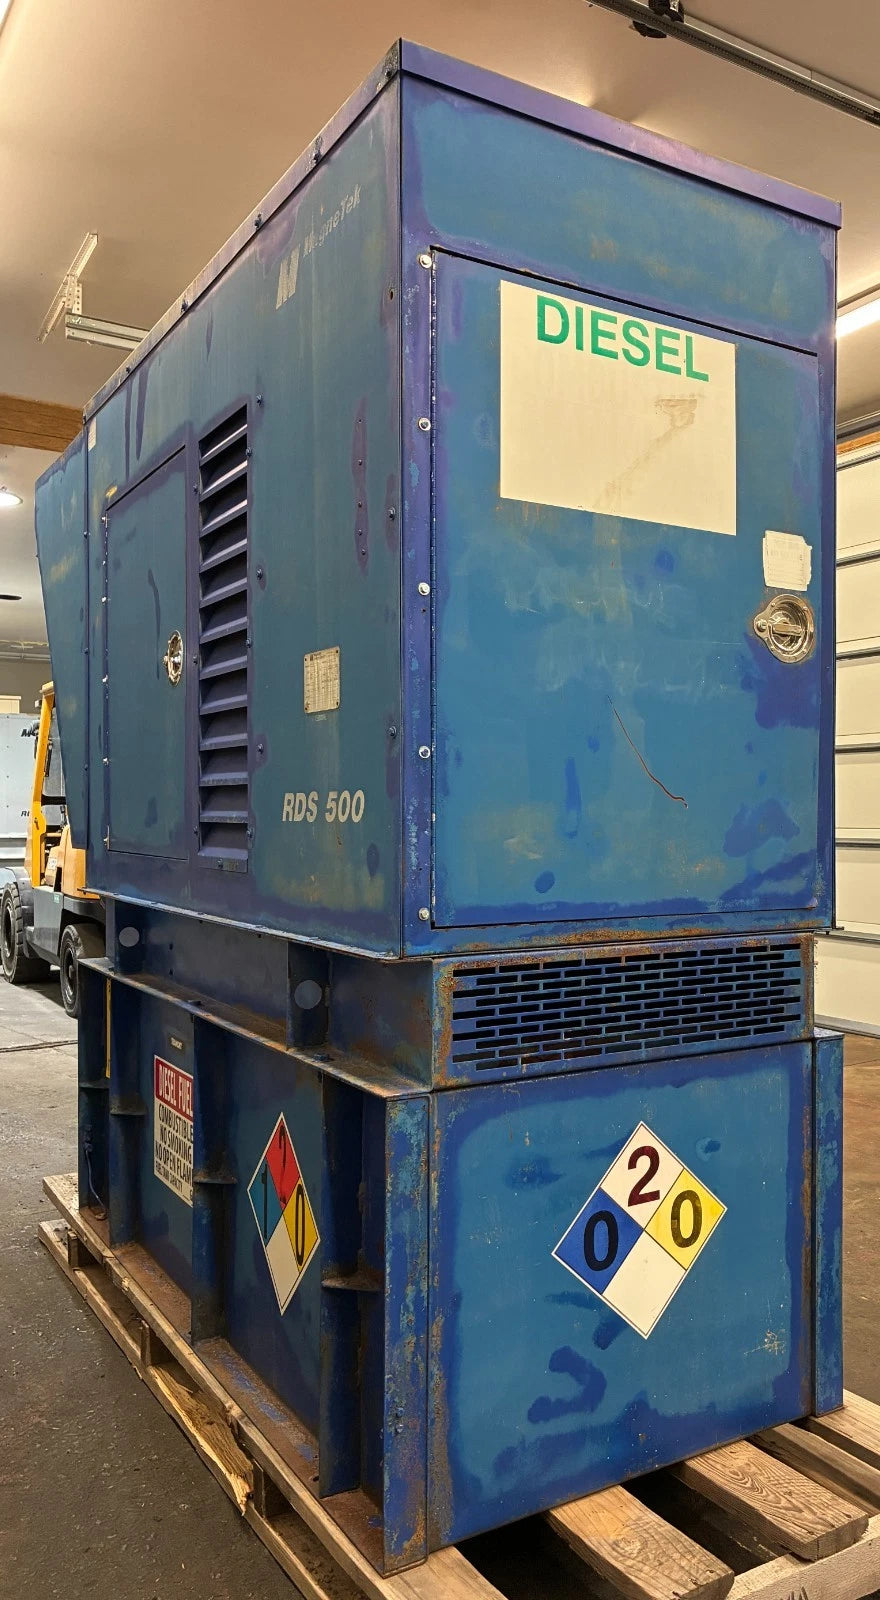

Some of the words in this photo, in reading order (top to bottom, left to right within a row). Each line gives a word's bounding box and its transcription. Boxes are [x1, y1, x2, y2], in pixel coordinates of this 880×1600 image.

[537, 295, 709, 382] DIESEL
[282, 791, 318, 822] RDS
[325, 790, 365, 823] 500
[159, 1064, 177, 1107] DIESEL
[178, 1075, 193, 1117] FUEL
[158, 1104, 193, 1145] COMBUSTIBLE
[160, 1124, 167, 1145] NO
[167, 1130, 192, 1165] SMOKING
[155, 1140, 162, 1161] NO
[163, 1146, 176, 1174] OPEN
[176, 1158, 192, 1188] FLAM
[628, 1146, 660, 1207] 2
[261, 1164, 268, 1239] 1
[295, 1184, 306, 1266] 0
[671, 1190, 703, 1249] 0
[583, 1210, 619, 1272] 0
